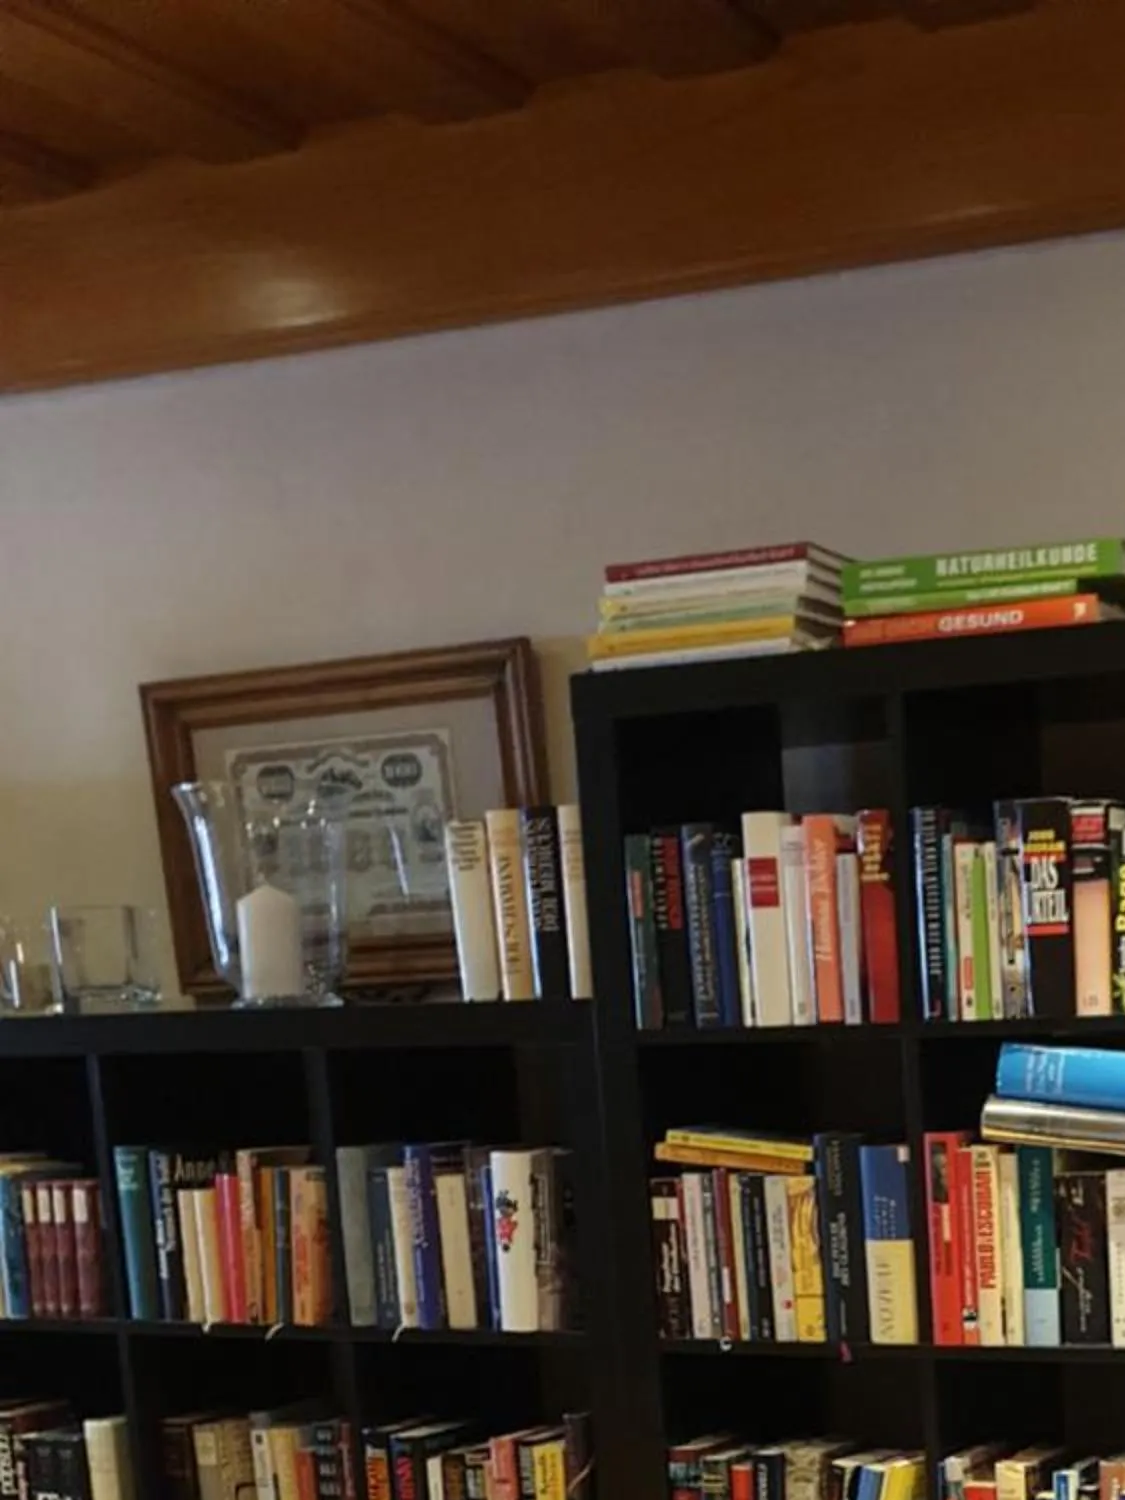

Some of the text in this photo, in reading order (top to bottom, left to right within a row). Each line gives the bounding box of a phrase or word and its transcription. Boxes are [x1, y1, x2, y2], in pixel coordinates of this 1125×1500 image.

[936, 542, 1098, 577] NATURHEILKUNDE
[938, 610, 1025, 632] GESUND
[1031, 855, 1059, 889] DAS
